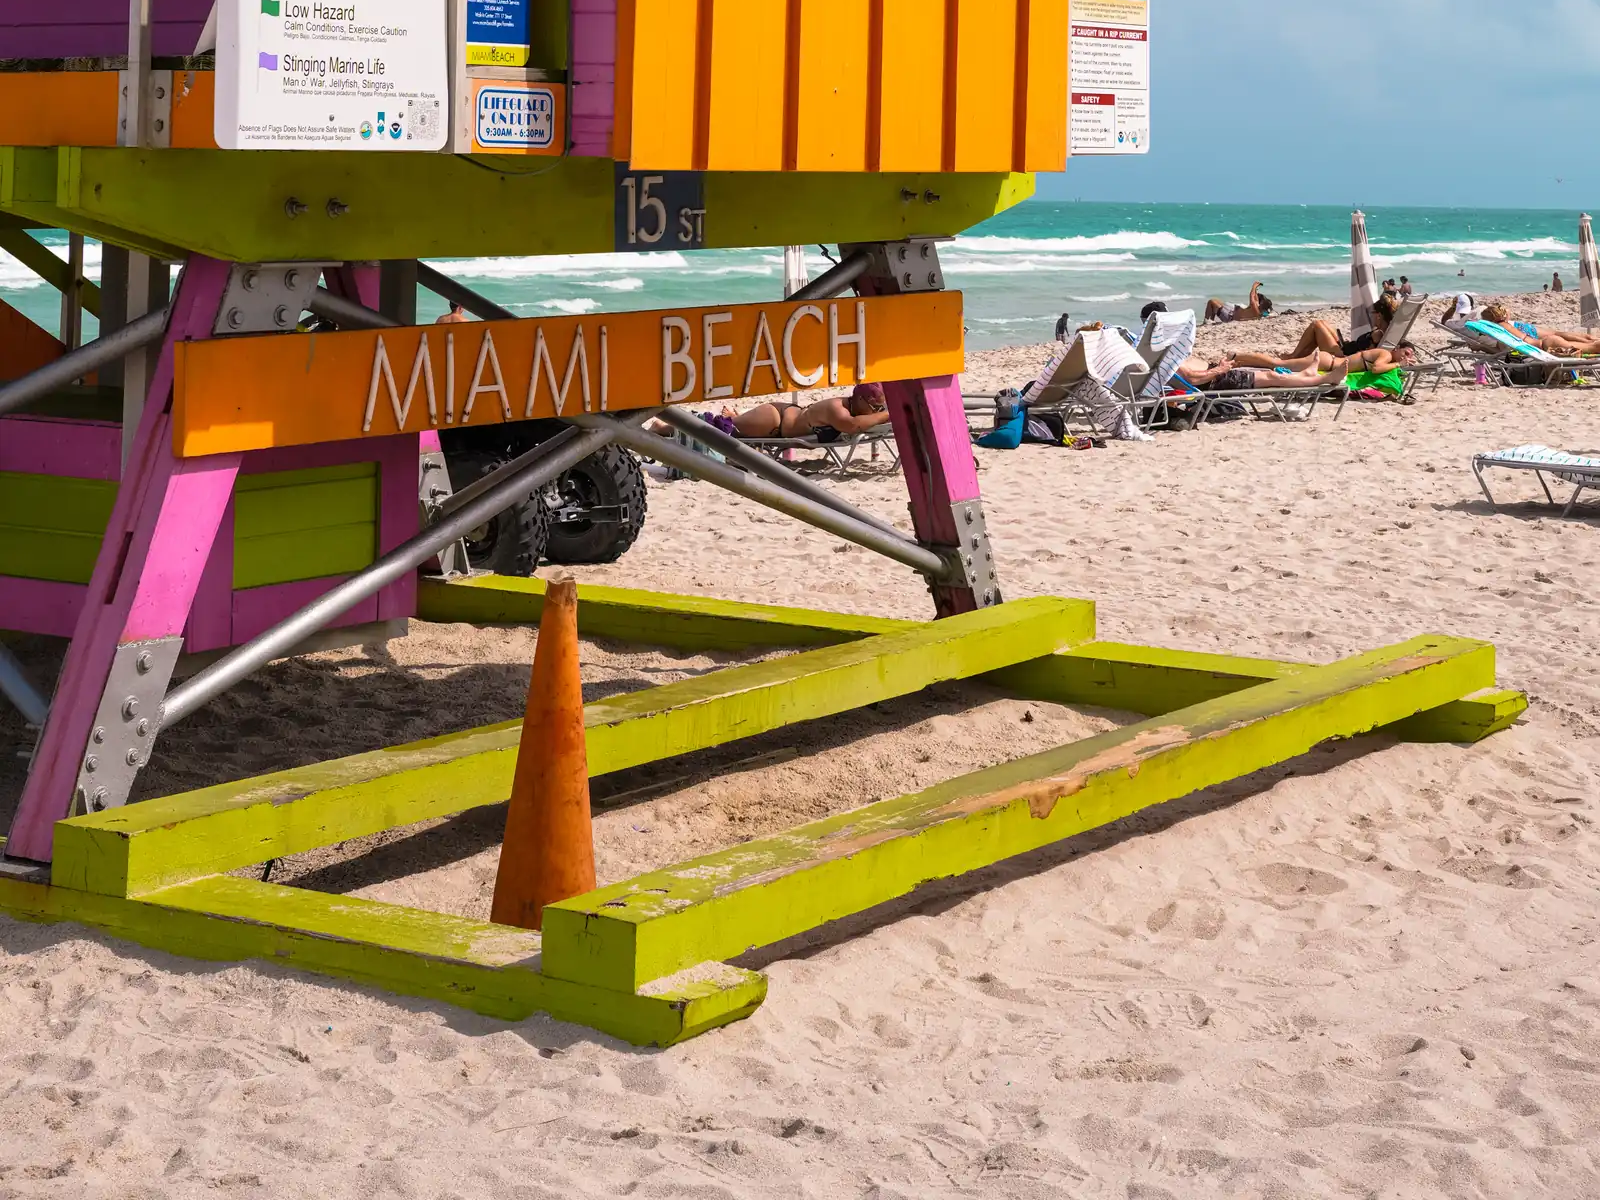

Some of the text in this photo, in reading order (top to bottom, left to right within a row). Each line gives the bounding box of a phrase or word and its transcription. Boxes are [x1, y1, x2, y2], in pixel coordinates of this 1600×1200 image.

[285, 0, 355, 21] Low Hazard
[284, 21, 407, 36] Calm Conditions, Exercise Caution
[1077, 28, 1097, 37] CAUGHT
[1119, 31, 1143, 40] CURRENT
[283, 54, 385, 77] Stinging Marine Life
[283, 77, 300, 87] Man
[310, 78, 327, 88] War,
[329, 78, 360, 90] Jellyfish,
[362, 79, 394, 91] Stingrays
[484, 97, 548, 112] LIFEGUARD
[1080, 96, 1100, 104] SAFETY
[491, 112, 541, 125] ON DUTY
[269, 125, 282, 133] Flags
[486, 128, 512, 136] 9:30AM
[520, 129, 545, 138] 6:30PM
[621, 176, 706, 243] 15 ST
[362, 301, 866, 432] MIAMI BEACH
